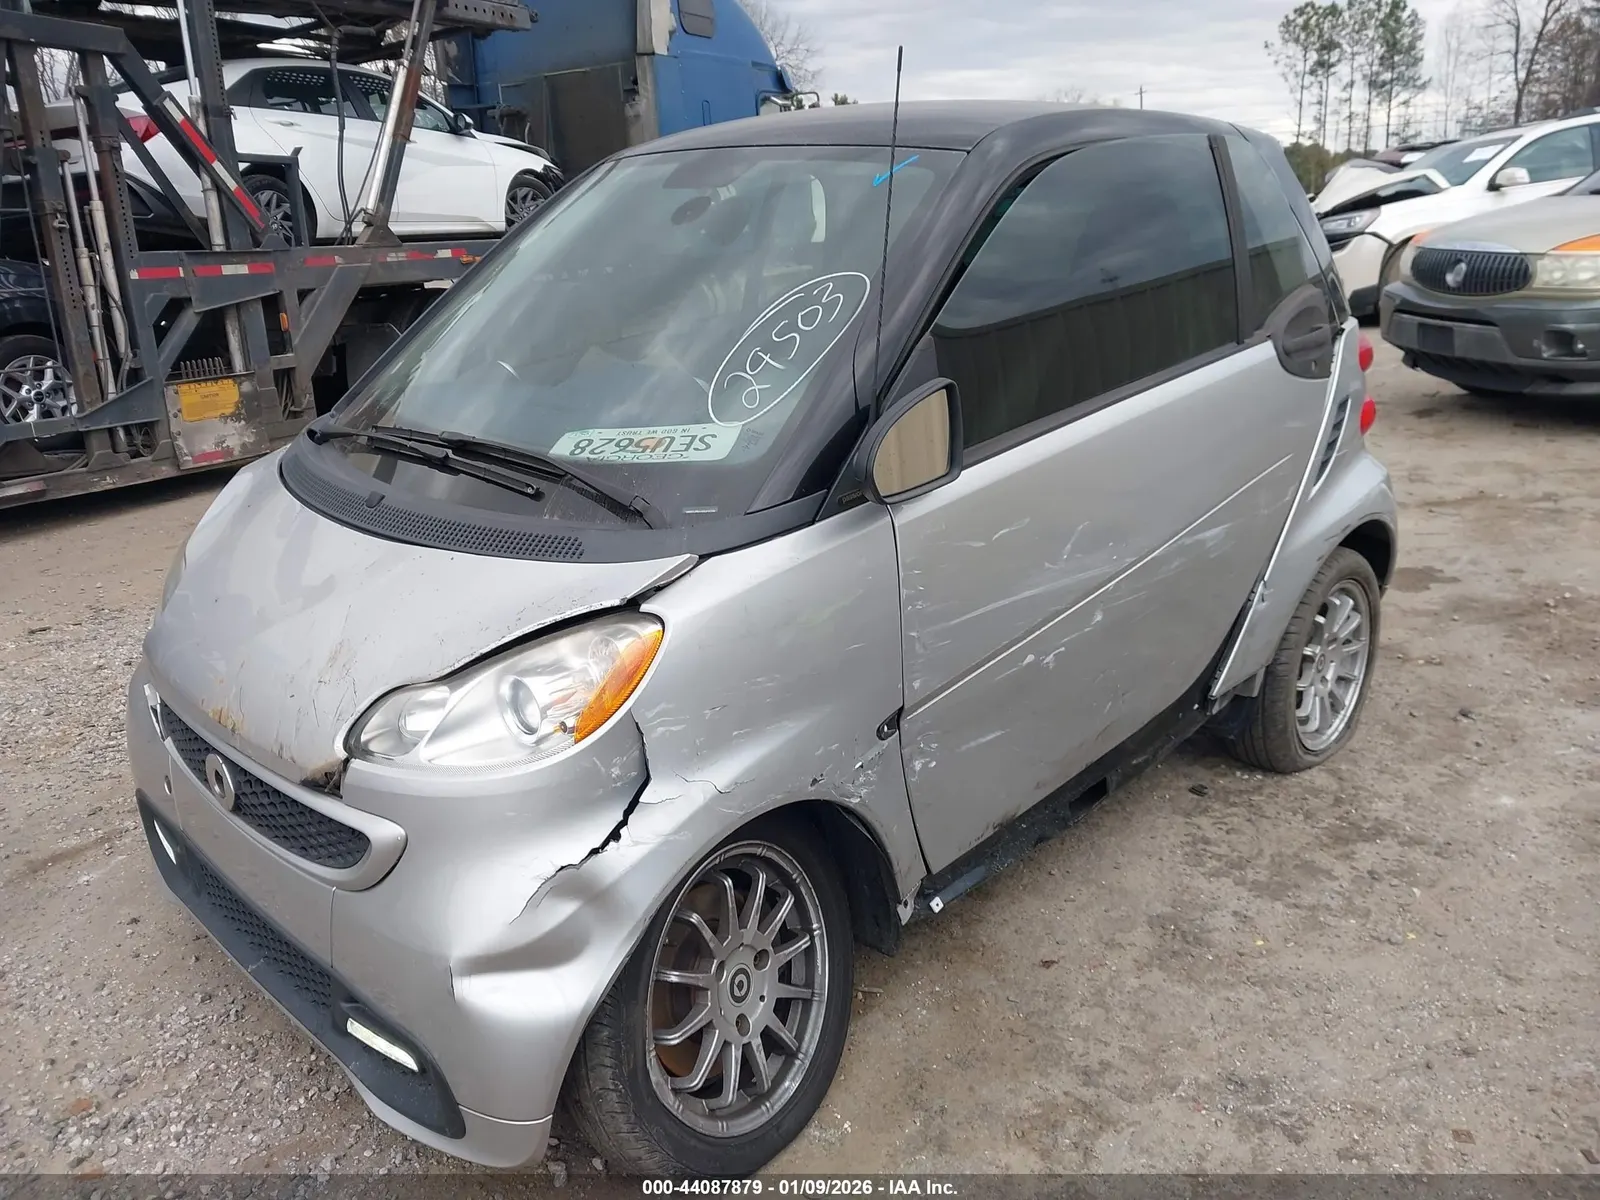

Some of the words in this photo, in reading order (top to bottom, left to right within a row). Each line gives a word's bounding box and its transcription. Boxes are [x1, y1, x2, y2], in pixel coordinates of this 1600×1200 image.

[723, 281, 844, 409] 29503
[568, 433, 718, 456] SEU5628
[585, 452, 684, 463] GEORGIA
